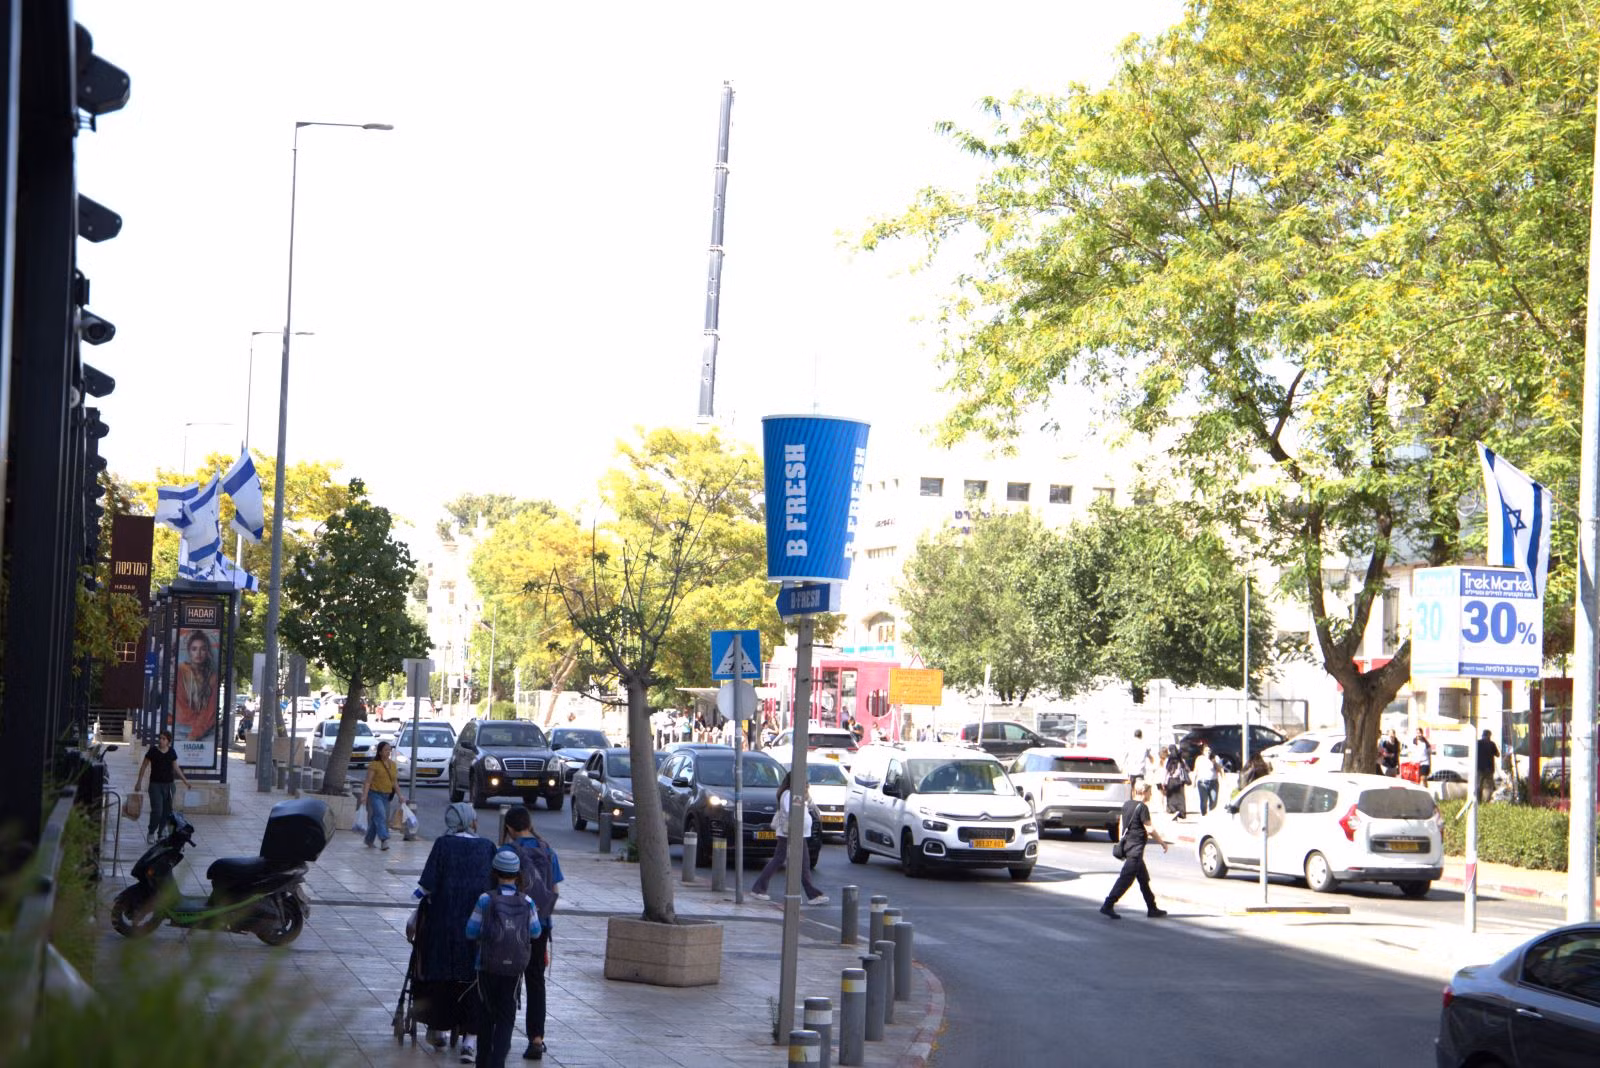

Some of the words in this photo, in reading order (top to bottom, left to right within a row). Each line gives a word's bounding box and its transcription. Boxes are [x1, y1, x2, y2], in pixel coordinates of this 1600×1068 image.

[785, 444, 807, 531] FRESH
[786, 538, 808, 557] B
[1463, 572, 1490, 590] Trek
[1490, 575, 1533, 592] Marke
[188, 607, 214, 618] HADAR
[1462, 600, 1537, 645] 30%
